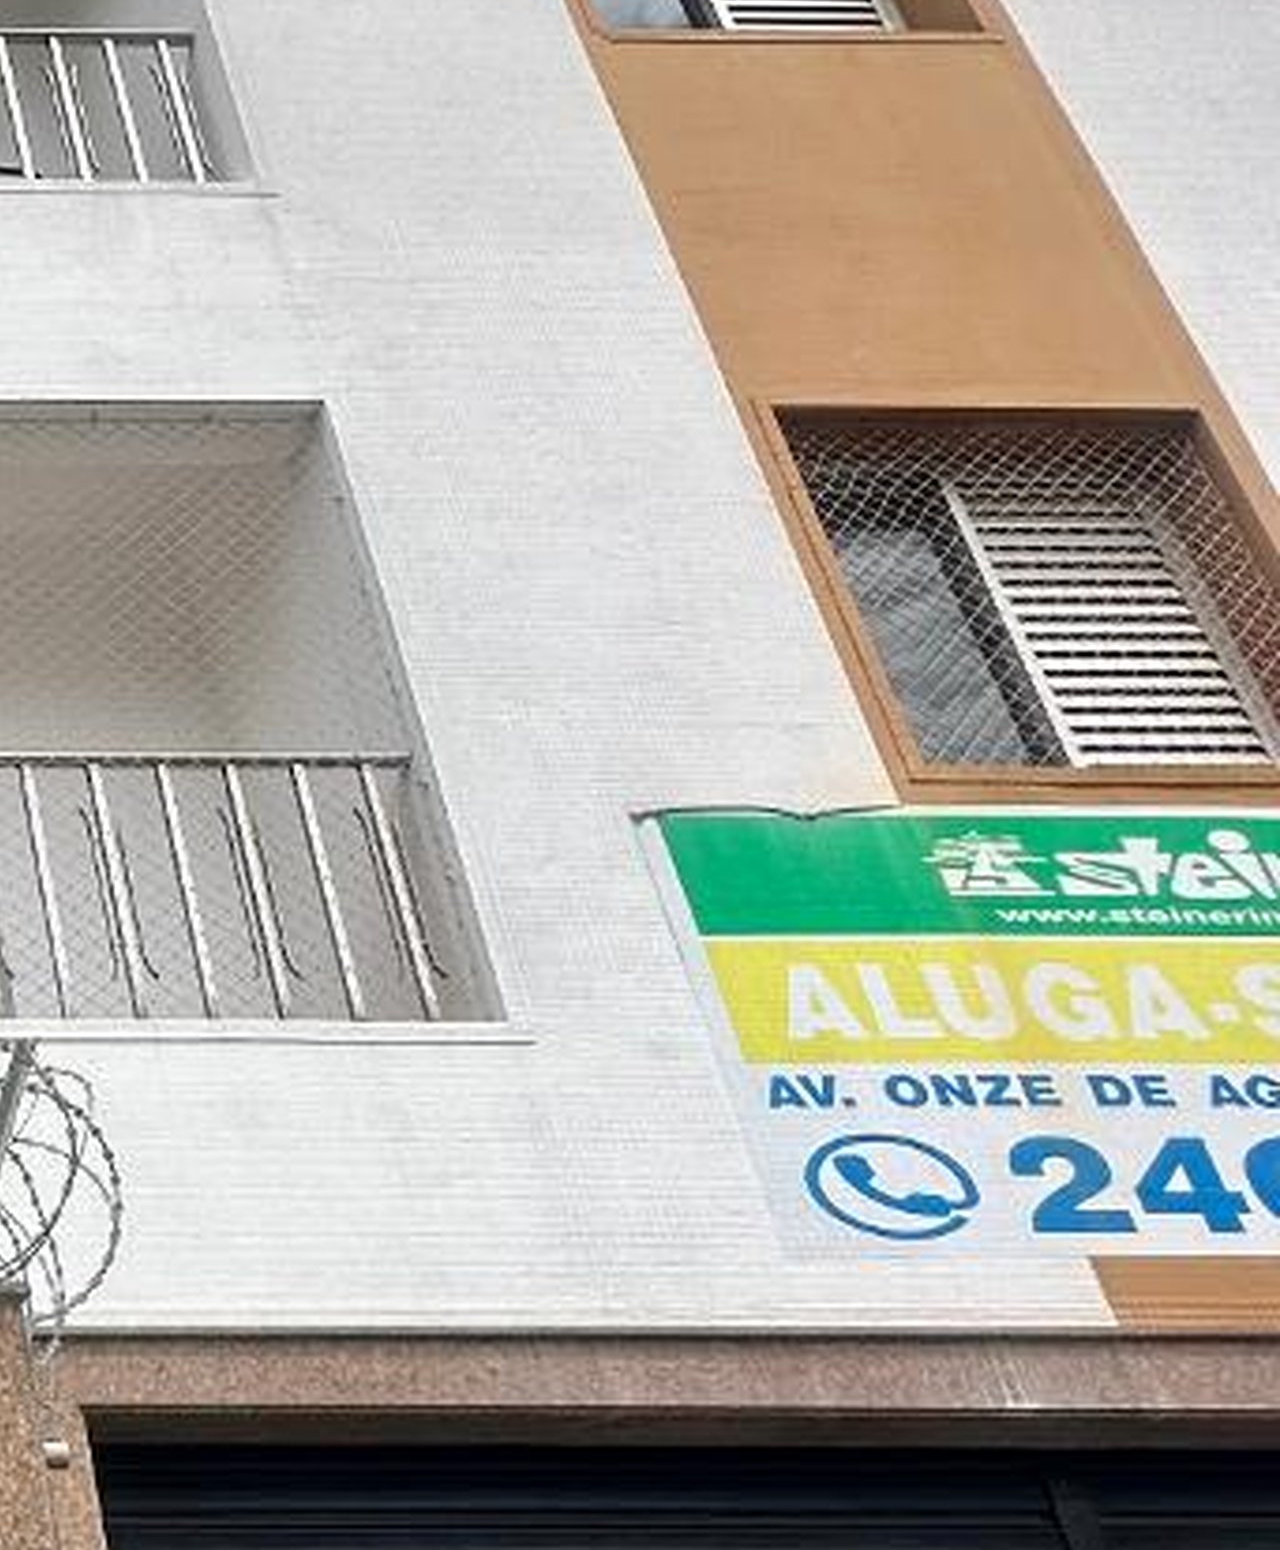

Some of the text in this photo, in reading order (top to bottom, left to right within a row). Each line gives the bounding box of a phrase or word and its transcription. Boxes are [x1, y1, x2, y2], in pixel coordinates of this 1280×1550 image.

[1056, 831, 1280, 899] stei
[769, 1074, 856, 1107] AV.
[884, 1074, 1062, 1107] ONZE
[1086, 1073, 1176, 1107] DE
